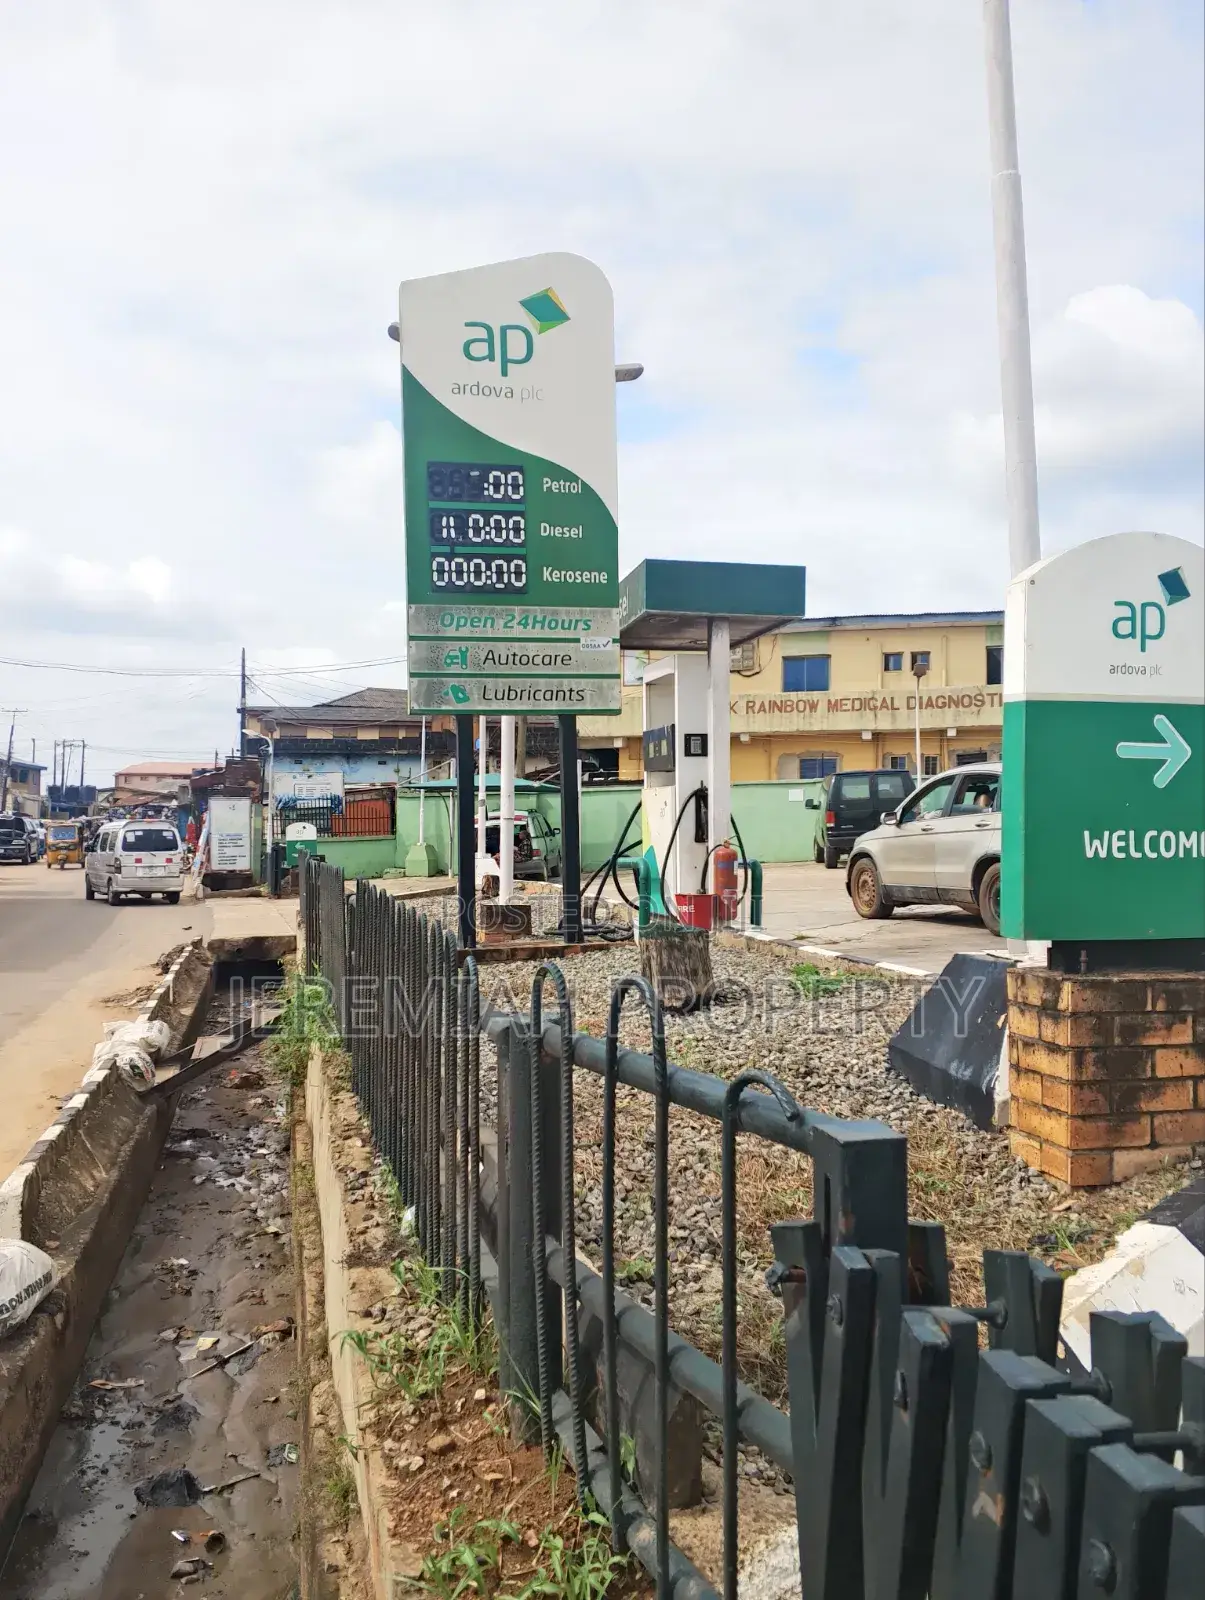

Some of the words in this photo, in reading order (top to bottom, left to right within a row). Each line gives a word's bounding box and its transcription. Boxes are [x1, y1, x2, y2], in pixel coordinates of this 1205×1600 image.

[462, 321, 534, 377] ap
[451, 381, 514, 399] ardova
[520, 385, 544, 403] plc
[543, 477, 582, 494] Petrol
[540, 522, 583, 539] Diesel
[432, 557, 526, 588] 000:00
[543, 566, 608, 584] Kerosene
[439, 612, 495, 630] Open
[1111, 600, 1166, 653] ap
[483, 650, 572, 667] Autocare
[1109, 662, 1147, 676] ardova
[1149, 663, 1163, 679] plc
[482, 685, 585, 702] Lubricants
[745, 699, 819, 715] RAINBOW
[827, 696, 900, 714] MEDICAL
